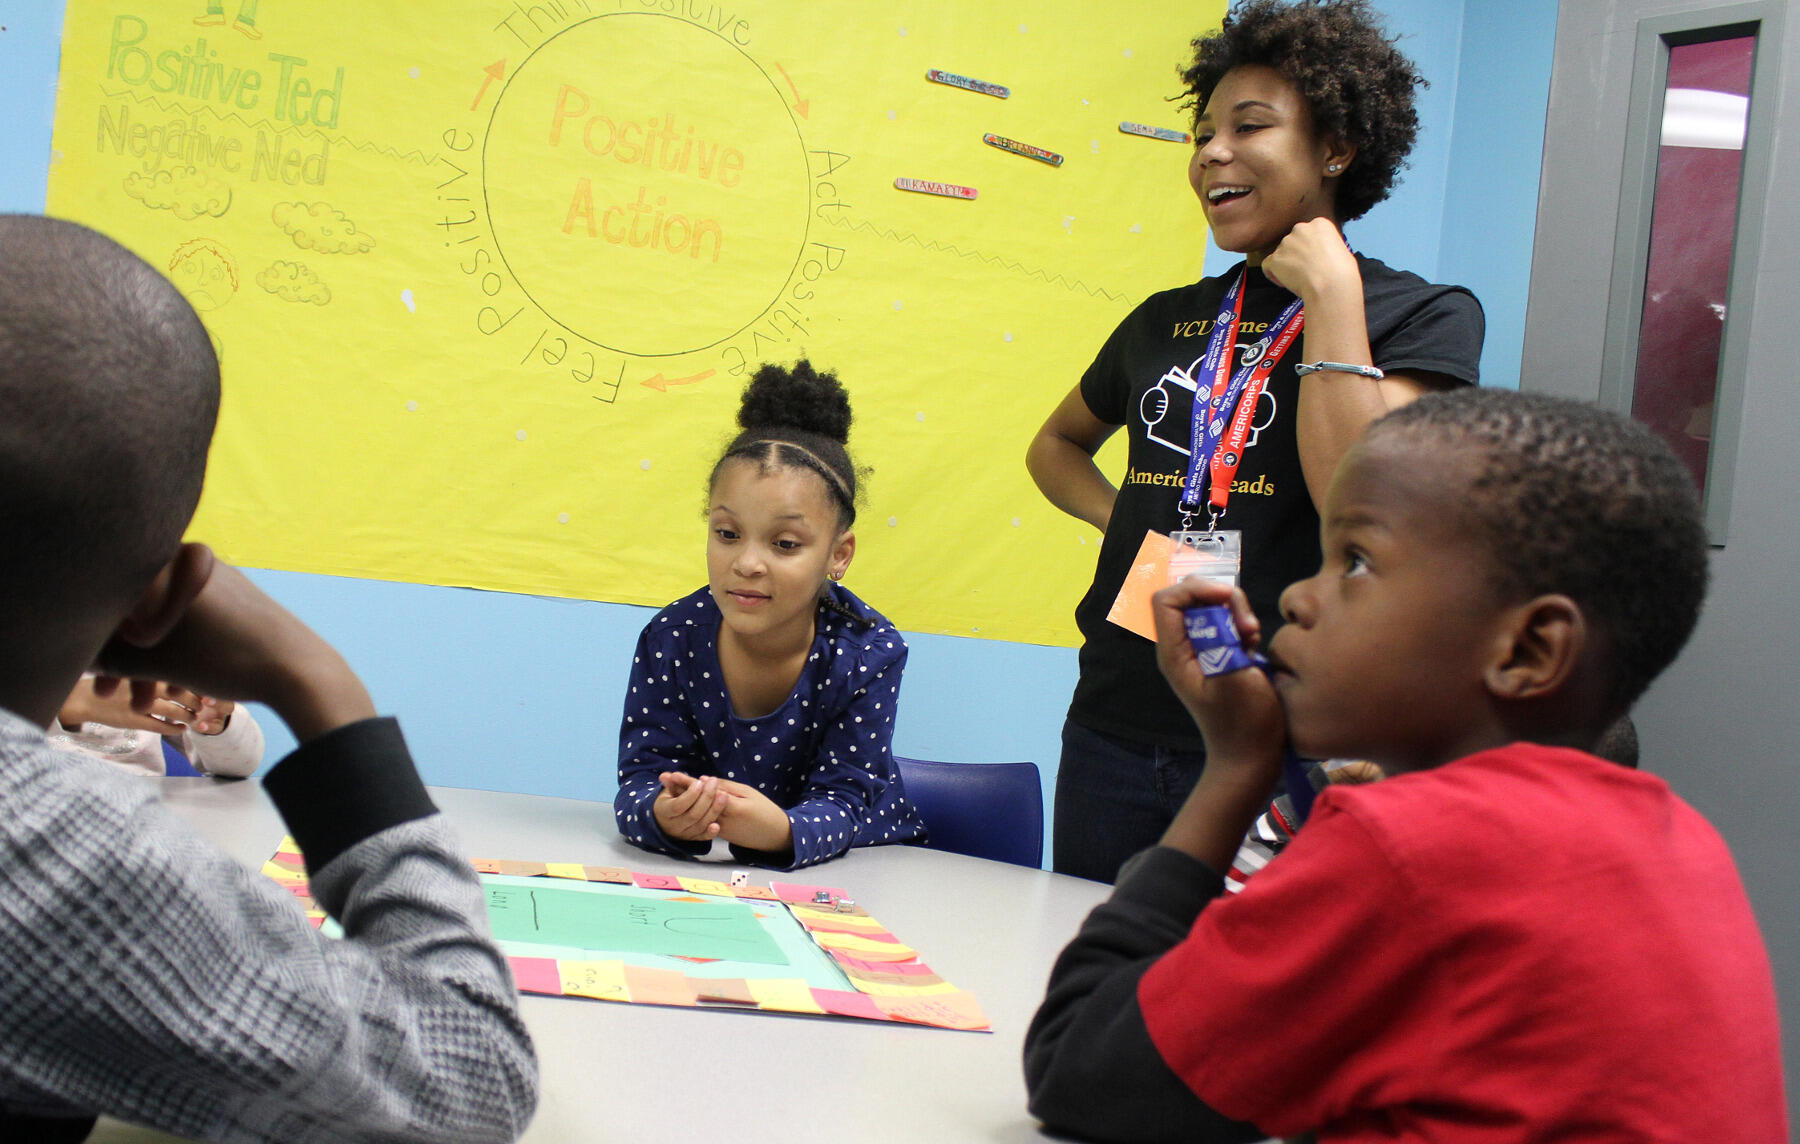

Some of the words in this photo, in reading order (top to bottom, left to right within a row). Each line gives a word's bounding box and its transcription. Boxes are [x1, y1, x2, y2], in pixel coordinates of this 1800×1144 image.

[493, 0, 592, 48] Thi
[618, 0, 751, 45] sitive
[107, 15, 262, 109] Positive
[268, 52, 344, 129] Ted
[97, 105, 242, 173] Negative
[251, 131, 329, 186] Ned
[549, 84, 745, 188] Positive
[562, 177, 723, 263] Action
[809, 150, 851, 218] Act
[436, 128, 524, 335] Positive
[722, 242, 846, 377] Positive
[1173, 320, 1217, 338] VCU
[520, 329, 626, 403] Feel
[1229, 379, 1261, 449] AMERICORPS
[1127, 466, 1187, 488] Americ
[1208, 474, 1275, 496] eads
